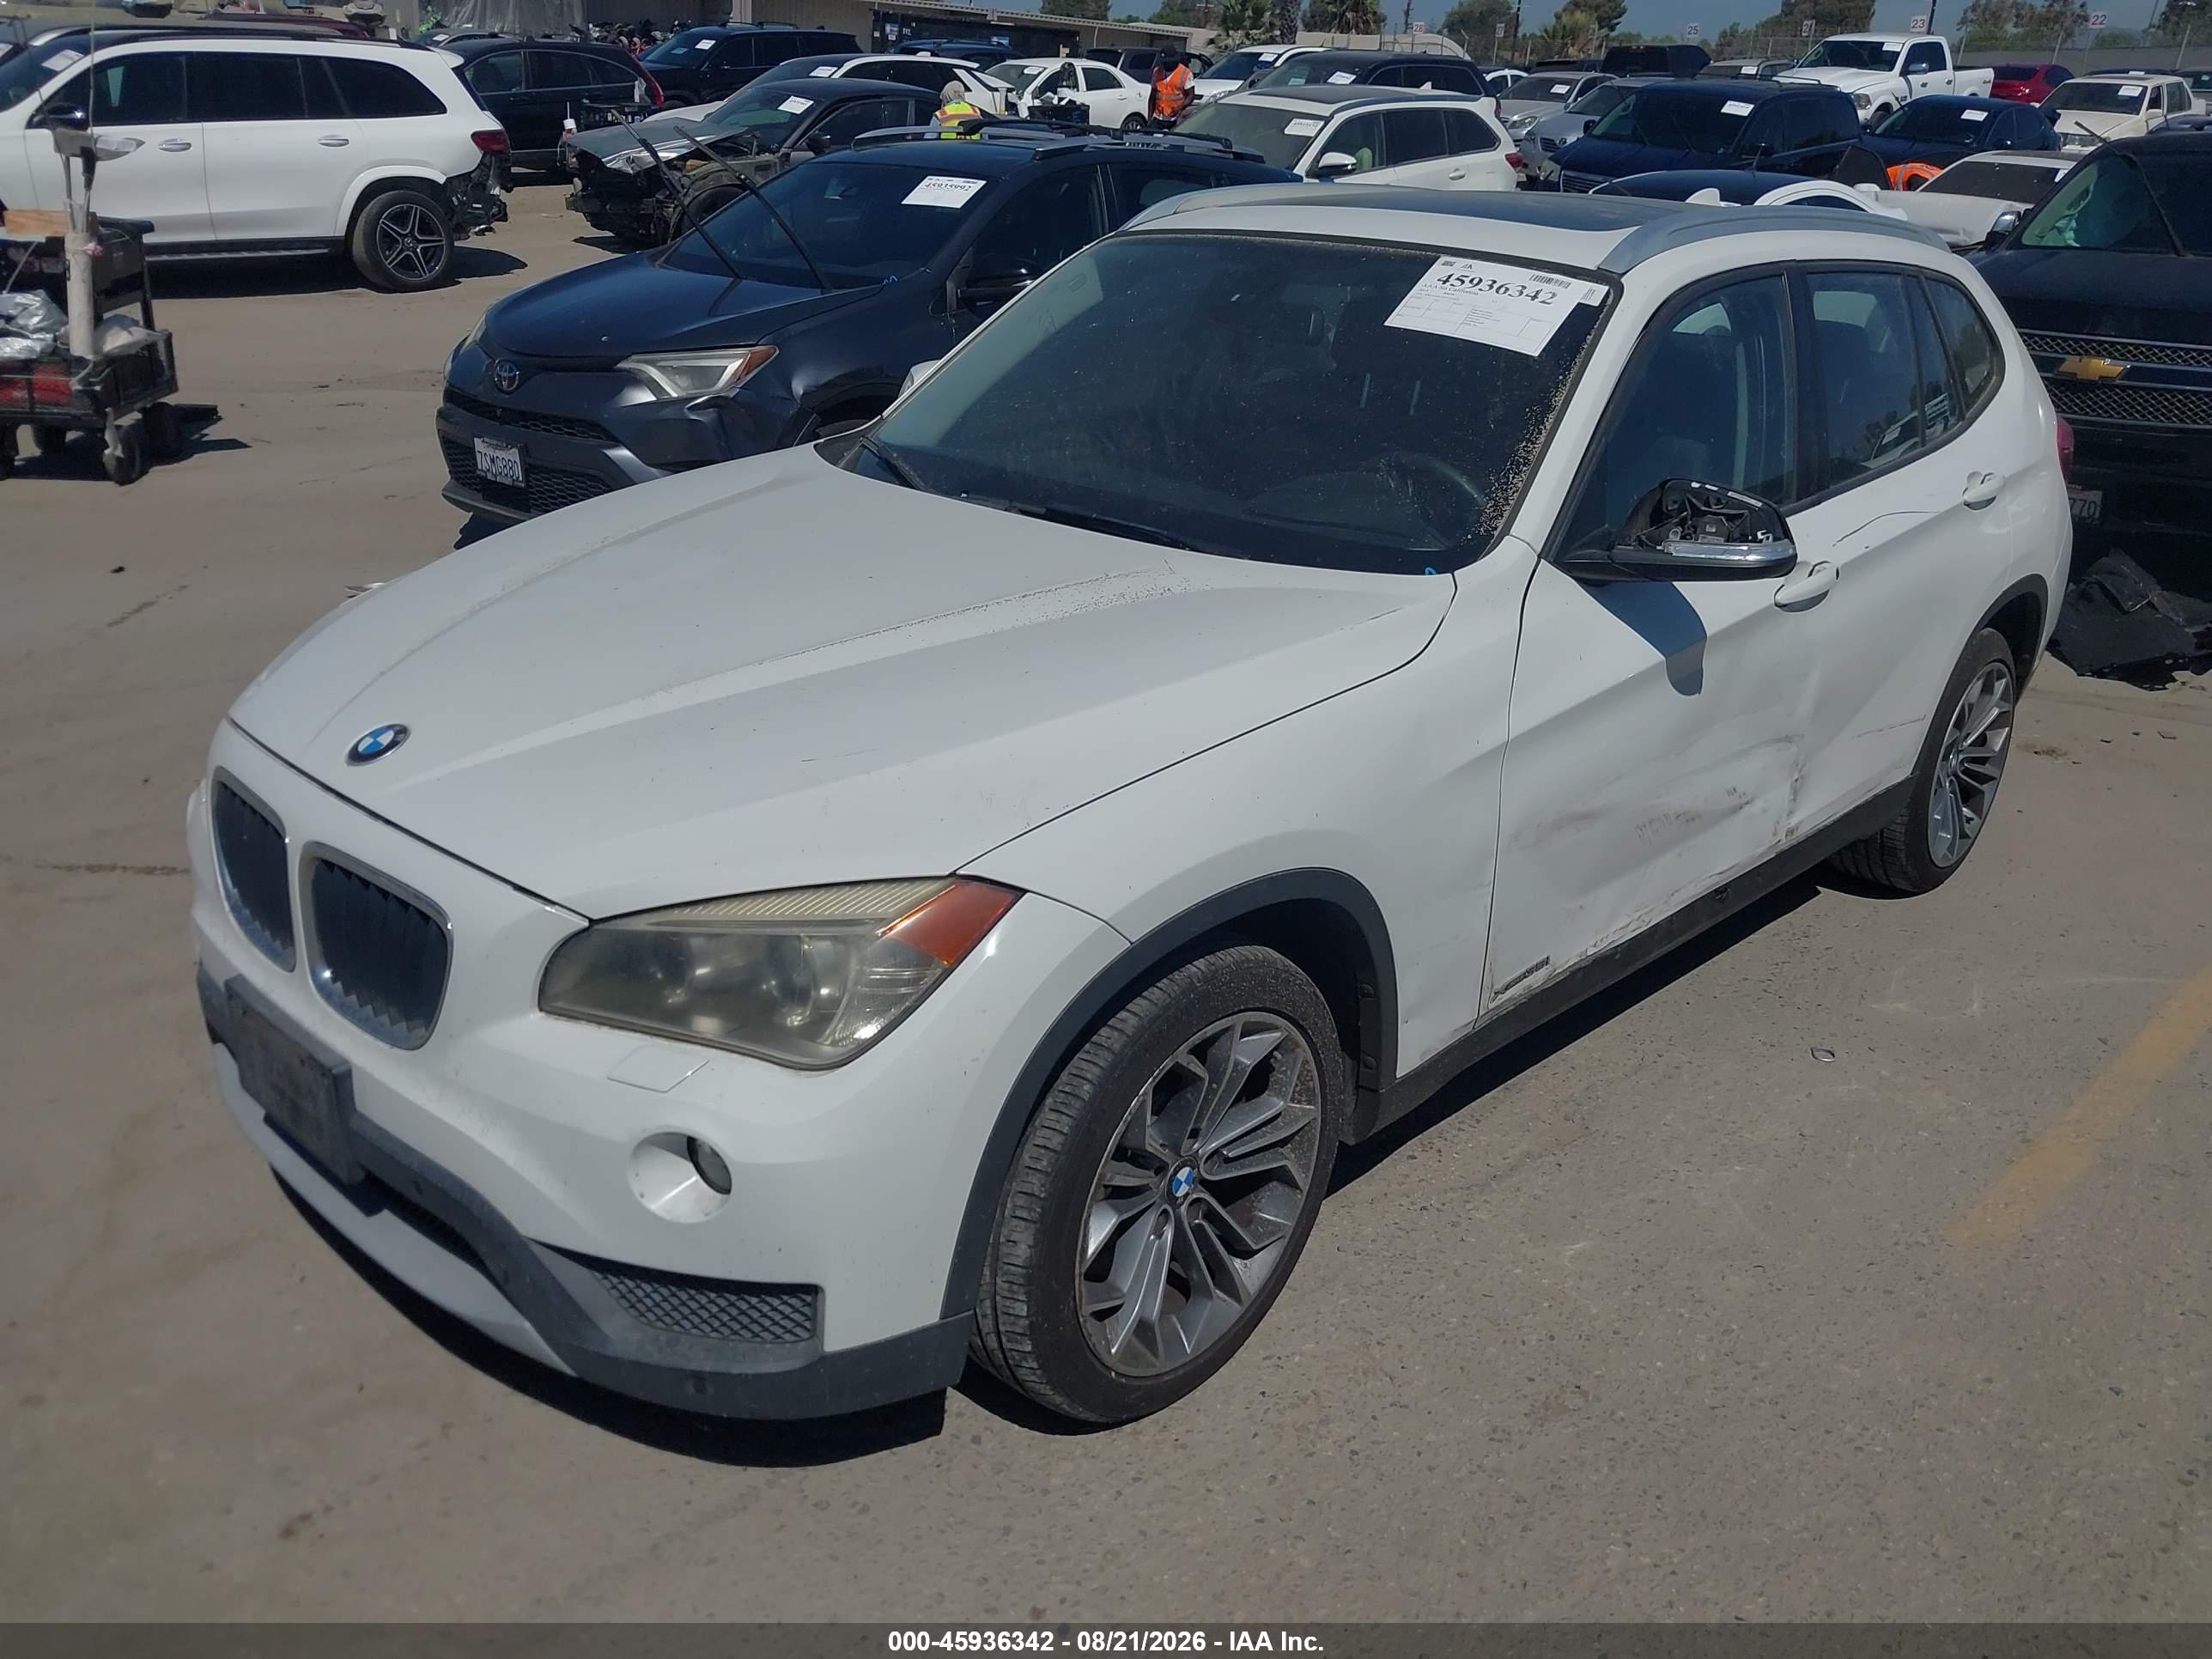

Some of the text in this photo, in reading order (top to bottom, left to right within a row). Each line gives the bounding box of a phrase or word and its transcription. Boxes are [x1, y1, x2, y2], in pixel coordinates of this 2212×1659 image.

[1911, 19, 1925, 28] 23
[2092, 14, 2106, 25] 22
[1687, 26, 1698, 35] 25
[1437, 272, 1558, 306] 45936342
